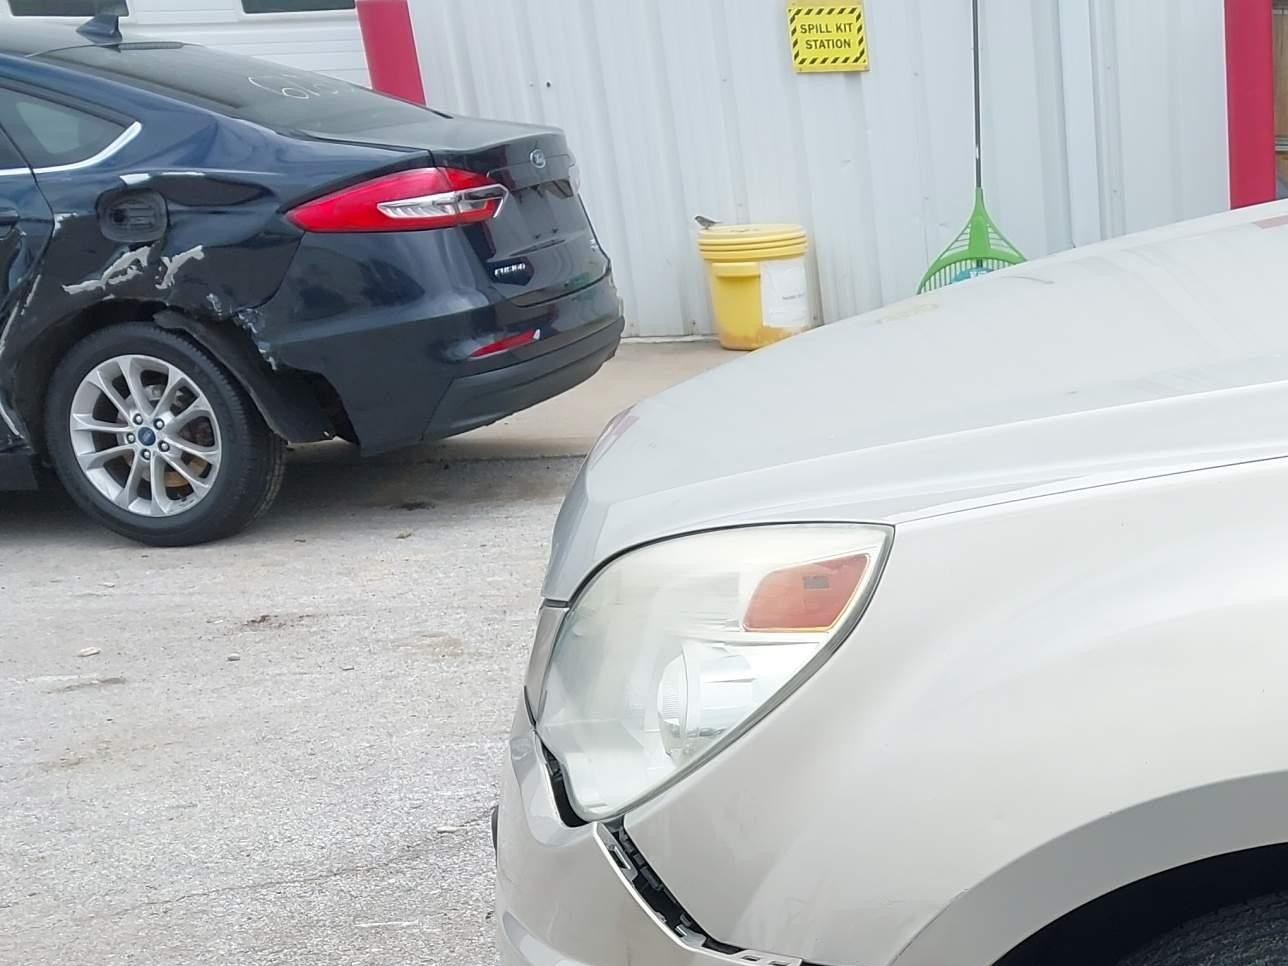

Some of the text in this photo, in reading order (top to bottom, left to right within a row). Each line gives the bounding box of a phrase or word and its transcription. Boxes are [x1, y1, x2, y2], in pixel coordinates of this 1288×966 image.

[800, 22, 853, 34] SPILL KIT
[805, 38, 851, 49] STATION
